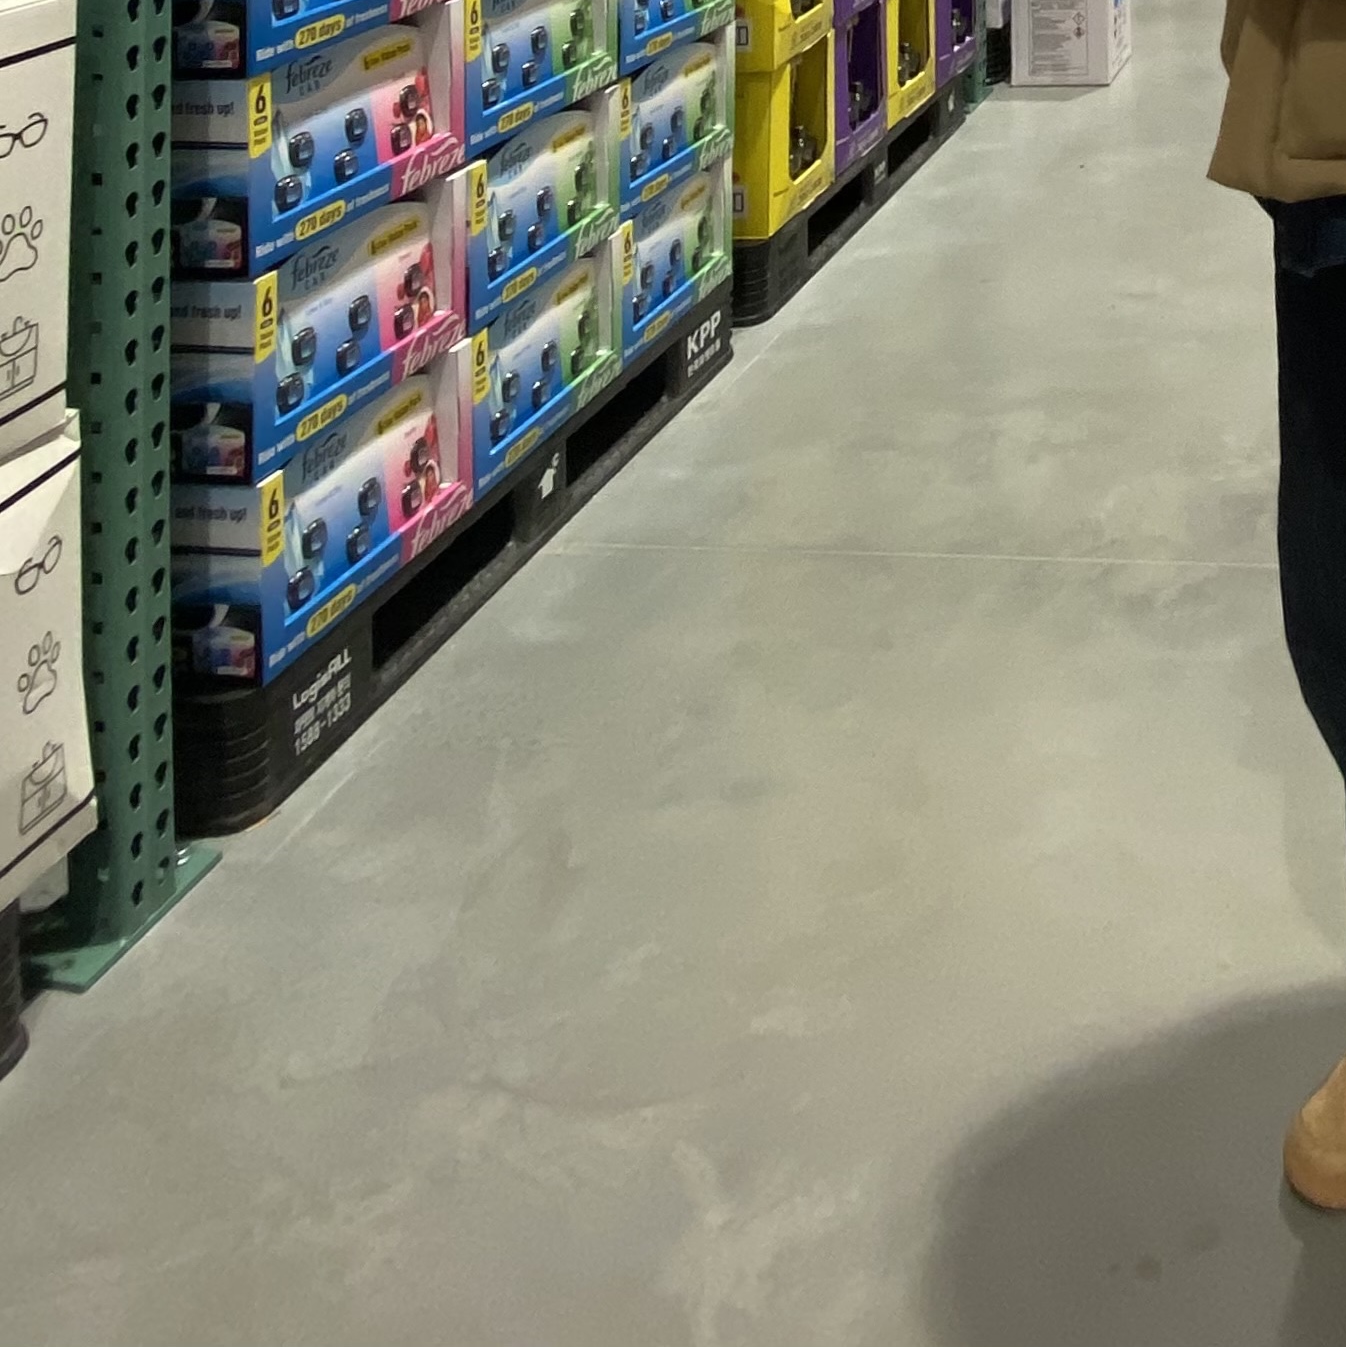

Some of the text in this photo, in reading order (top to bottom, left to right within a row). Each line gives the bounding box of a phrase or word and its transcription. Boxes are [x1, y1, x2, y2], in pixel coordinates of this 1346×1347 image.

[470, 0, 479, 25] 6
[299, 26, 317, 48] 270
[318, 20, 342, 43] days
[285, 54, 334, 95] febreze
[216, 102, 235, 117] up!
[255, 82, 267, 114] 6
[621, 87, 629, 110] 6
[400, 136, 466, 196] febreze
[476, 172, 485, 199] 6
[299, 216, 317, 238] 270
[318, 205, 343, 230] days
[290, 244, 340, 293] febreze
[223, 304, 242, 321] up!
[262, 285, 273, 316] 6
[401, 313, 467, 383] febreze
[686, 309, 722, 361] KPP
[475, 341, 485, 366] 6
[299, 415, 319, 440] 270
[319, 400, 346, 428] days
[229, 507, 247, 524] up!
[268, 488, 280, 520] 6
